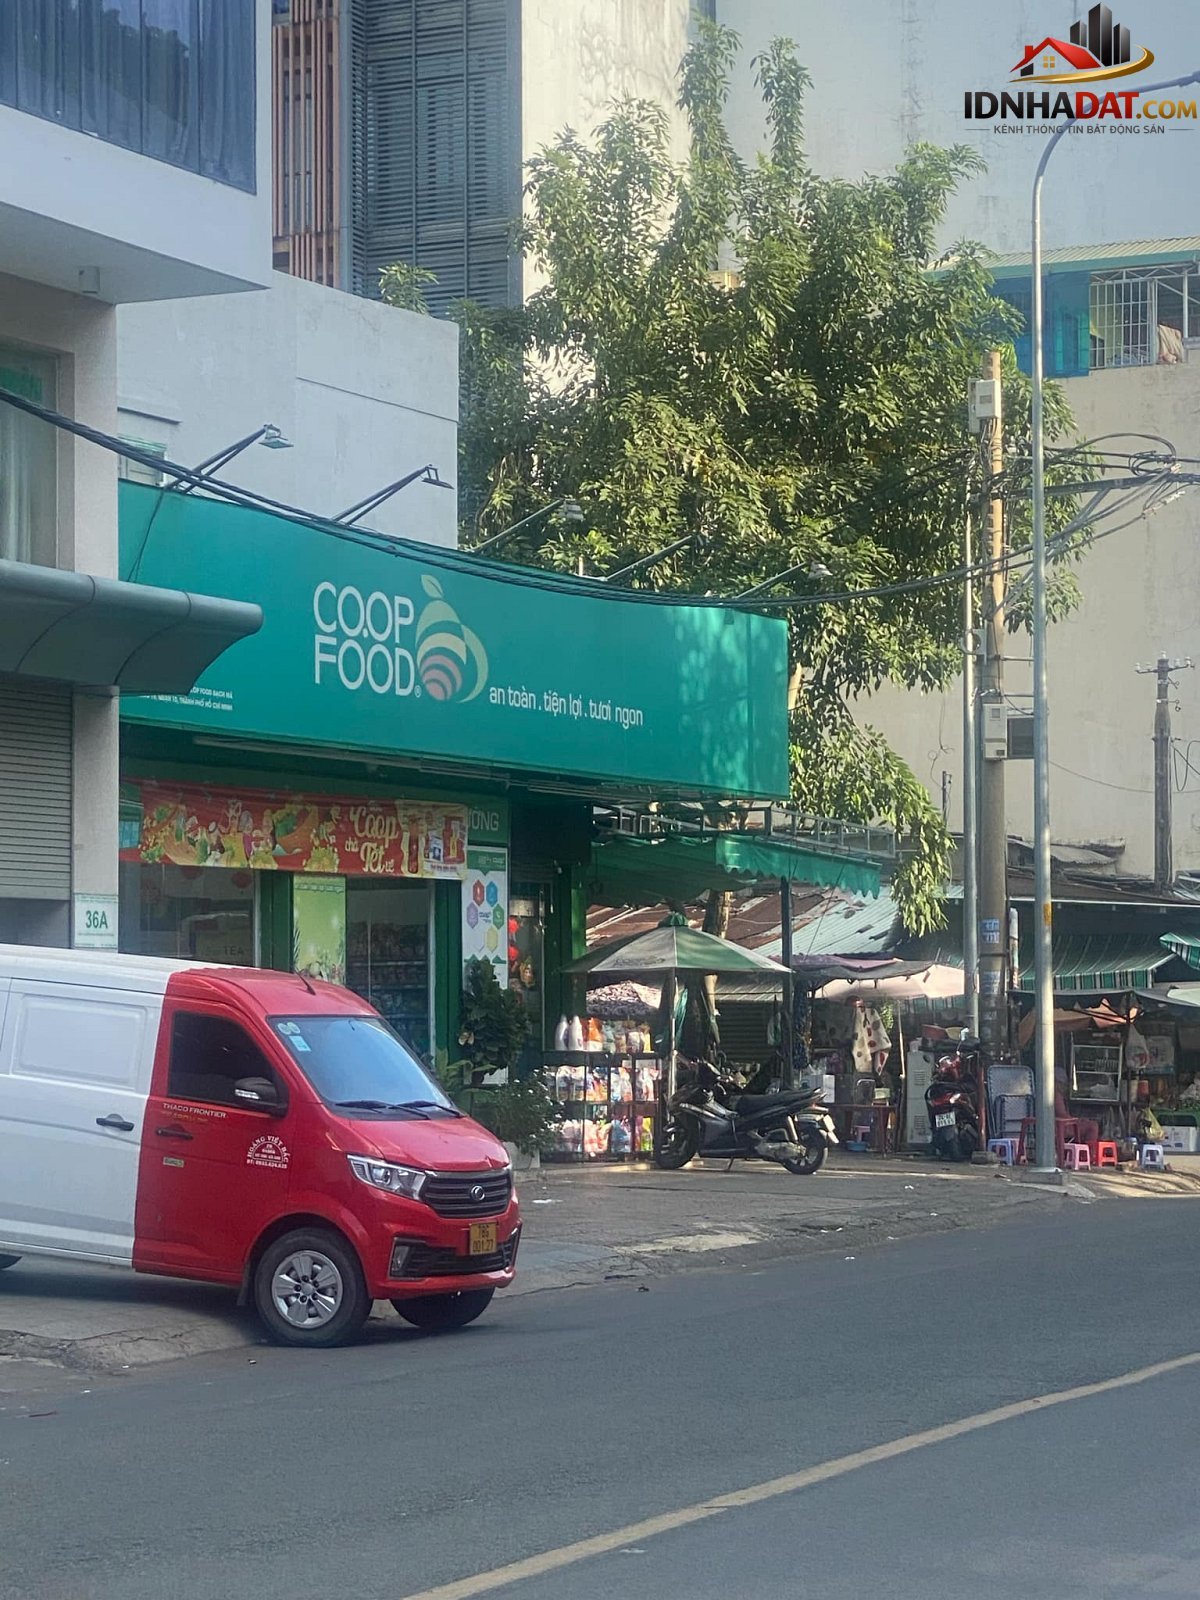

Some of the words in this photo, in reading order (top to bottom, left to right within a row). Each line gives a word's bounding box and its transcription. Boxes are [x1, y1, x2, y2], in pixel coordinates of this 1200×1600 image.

[489, 686, 505, 705] an
[508, 685, 536, 710] toàn
[543, 690, 566, 717] tiện
[569, 693, 583, 720] lợi
[589, 699, 611, 721] tươi
[615, 706, 643, 730] ngon
[85, 910, 108, 929] 36A
[162, 1102, 189, 1112] THACO
[189, 1106, 227, 1118] FRONTIER
